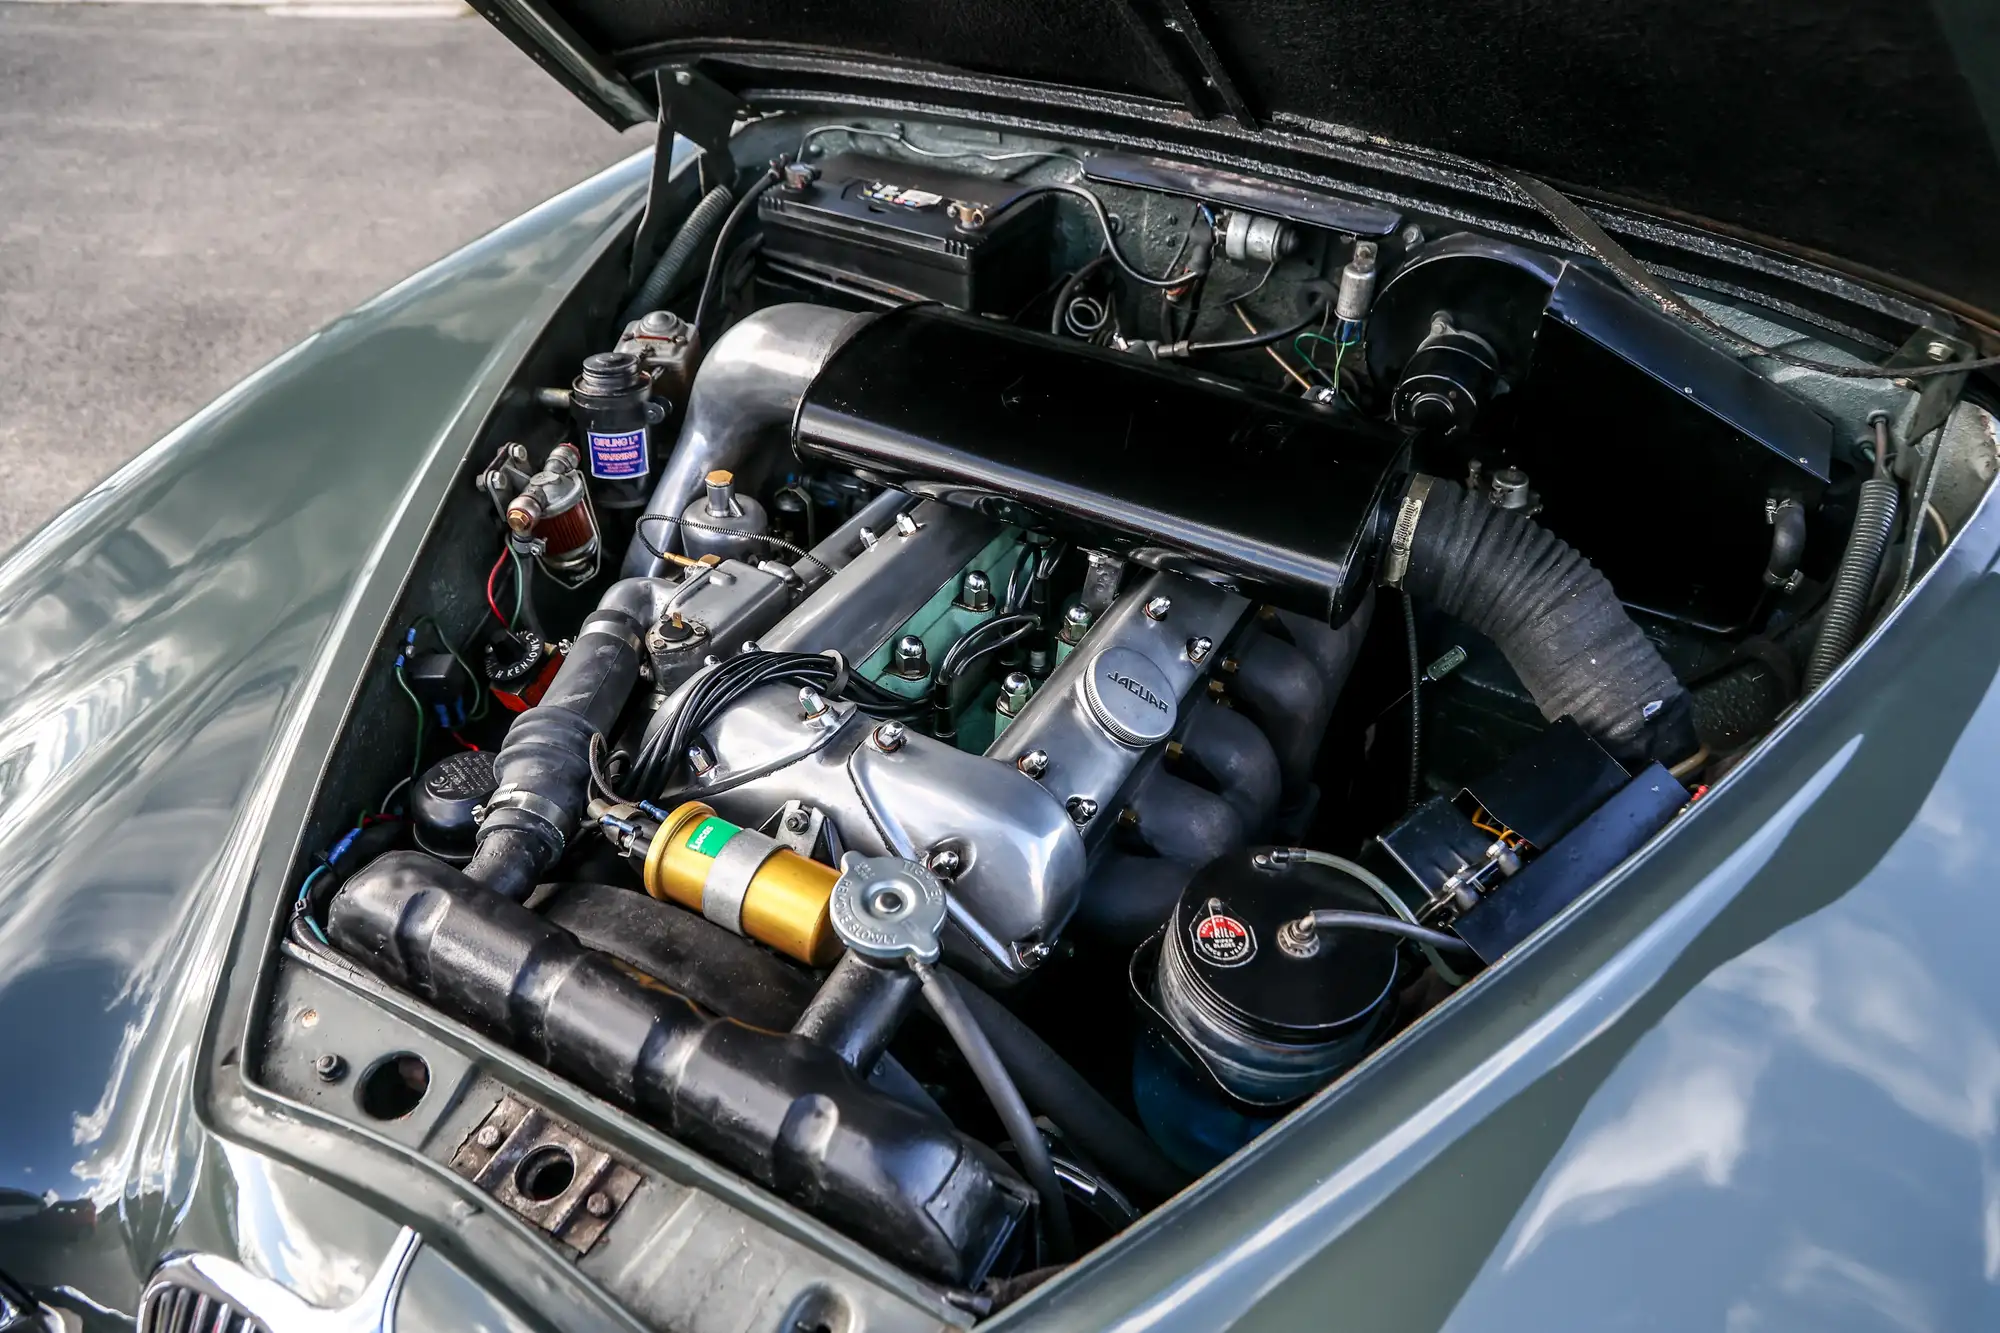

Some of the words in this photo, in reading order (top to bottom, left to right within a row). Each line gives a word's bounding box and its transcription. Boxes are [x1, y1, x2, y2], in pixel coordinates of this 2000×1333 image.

[593, 436, 628, 448] GIRLING
[507, 638, 540, 677] KENLOWE
[1106, 670, 1169, 714] JAGUAR
[688, 825, 714, 850] Lucas
[848, 923, 898, 945] SLOWLY
[1204, 943, 1221, 957] ONCE
[1229, 942, 1244, 955] YEAR
